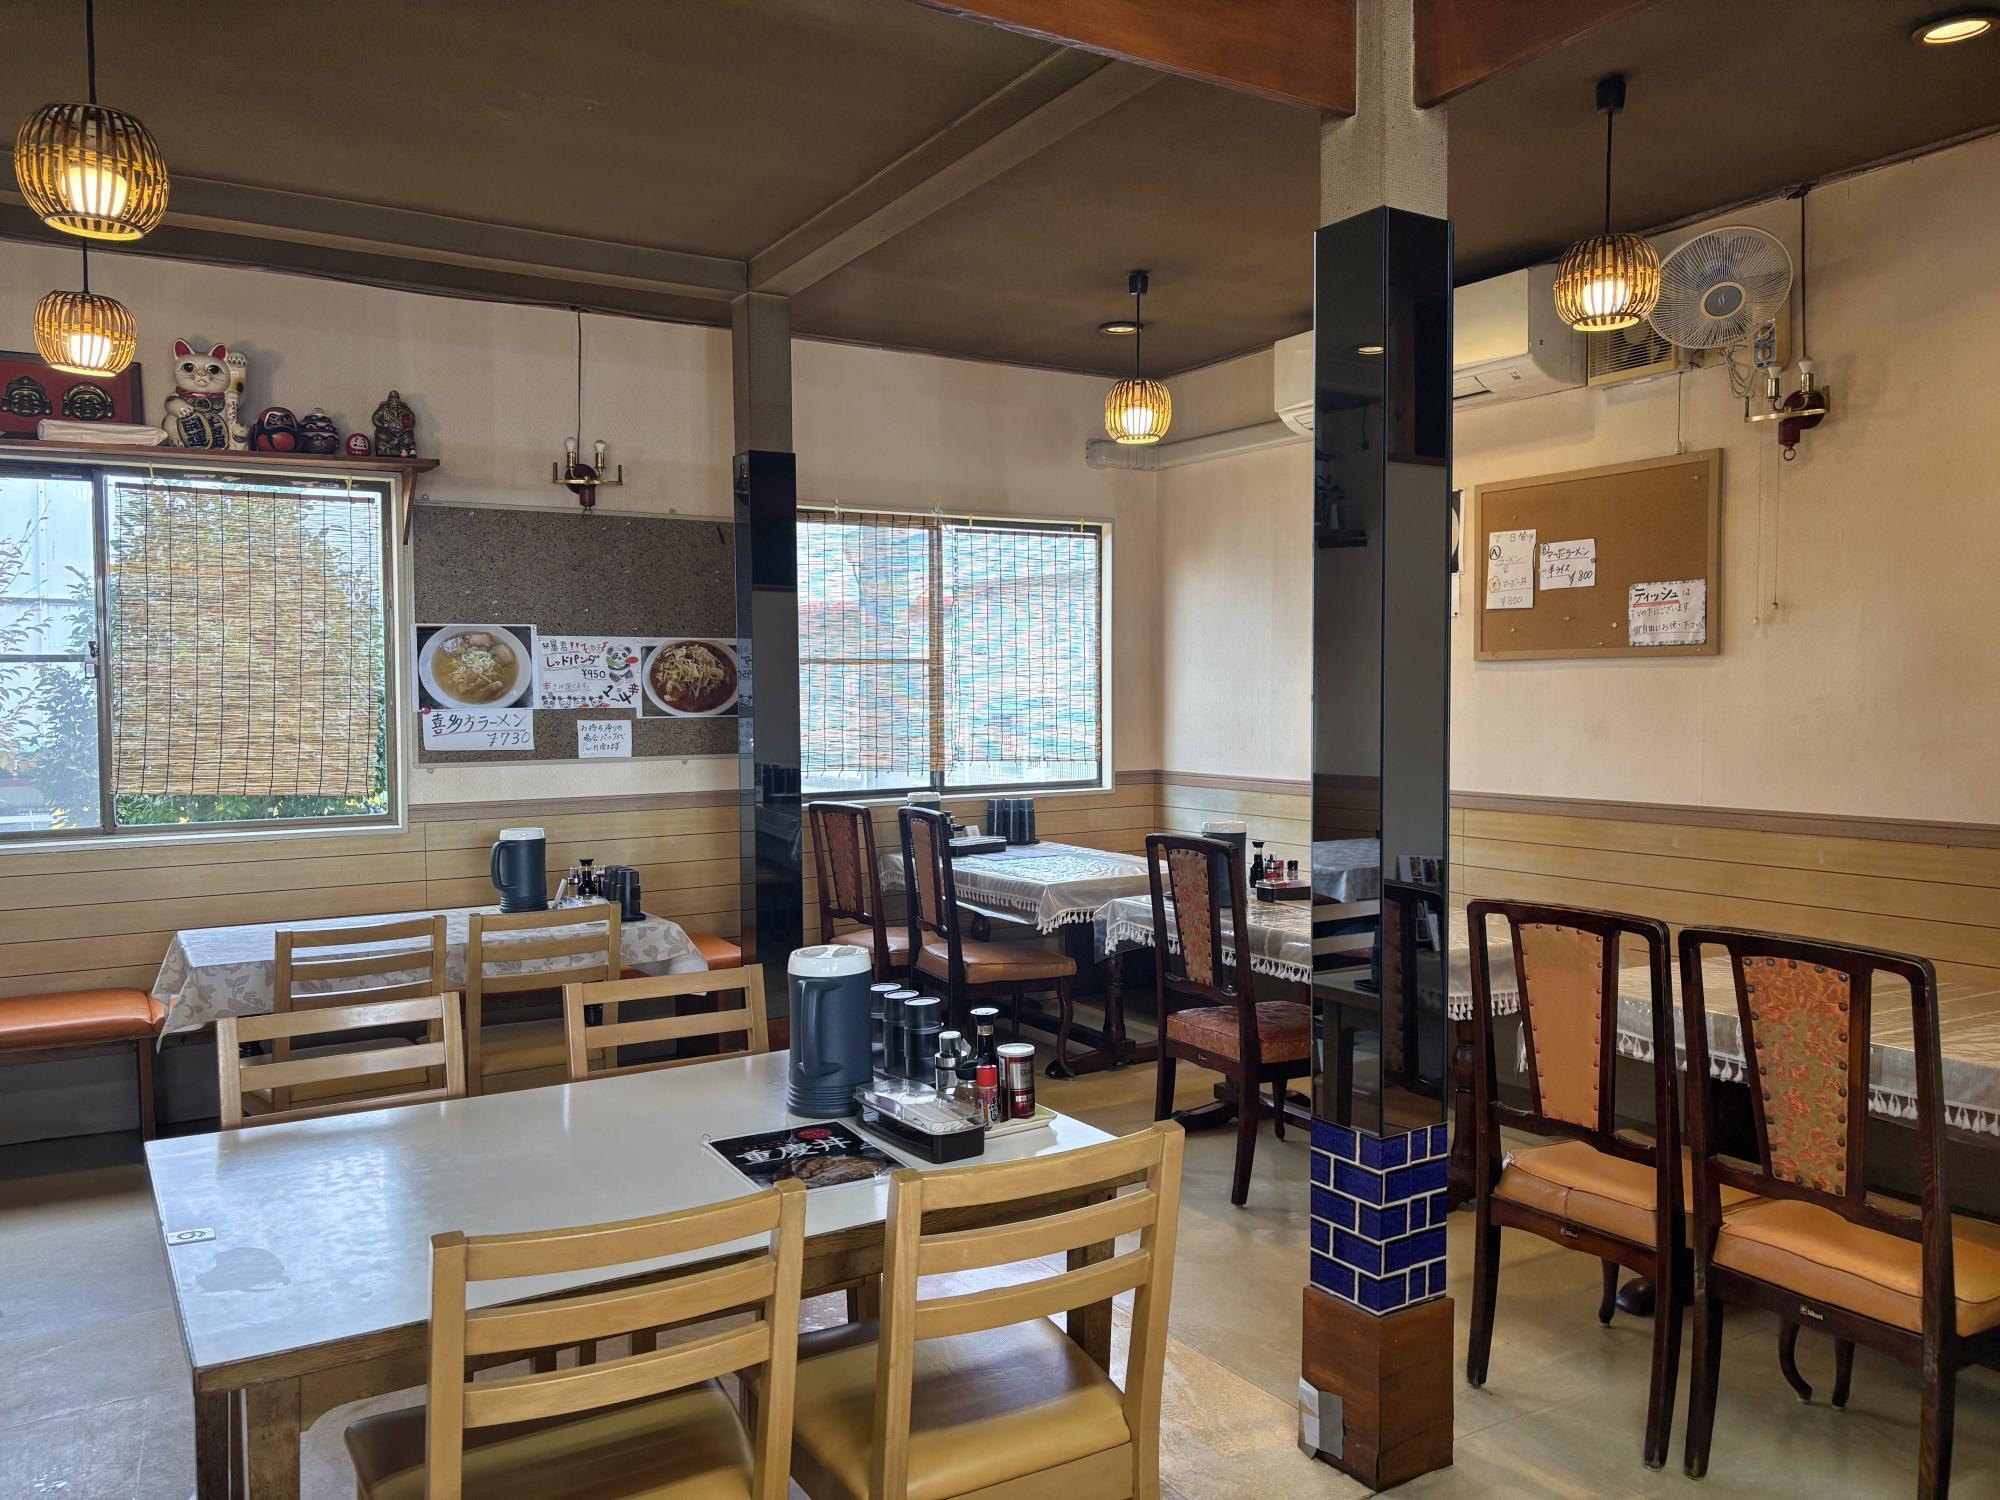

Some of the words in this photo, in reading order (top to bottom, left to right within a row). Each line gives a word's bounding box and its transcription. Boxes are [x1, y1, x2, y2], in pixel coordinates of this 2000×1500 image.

[1569, 570, 1593, 586] ¥800
[546, 654, 600, 668] レッドパンダ
[582, 668, 606, 679] ¥950
[432, 712, 527, 735] 喜多方ラーメン
[487, 732, 531, 748] ¥730
